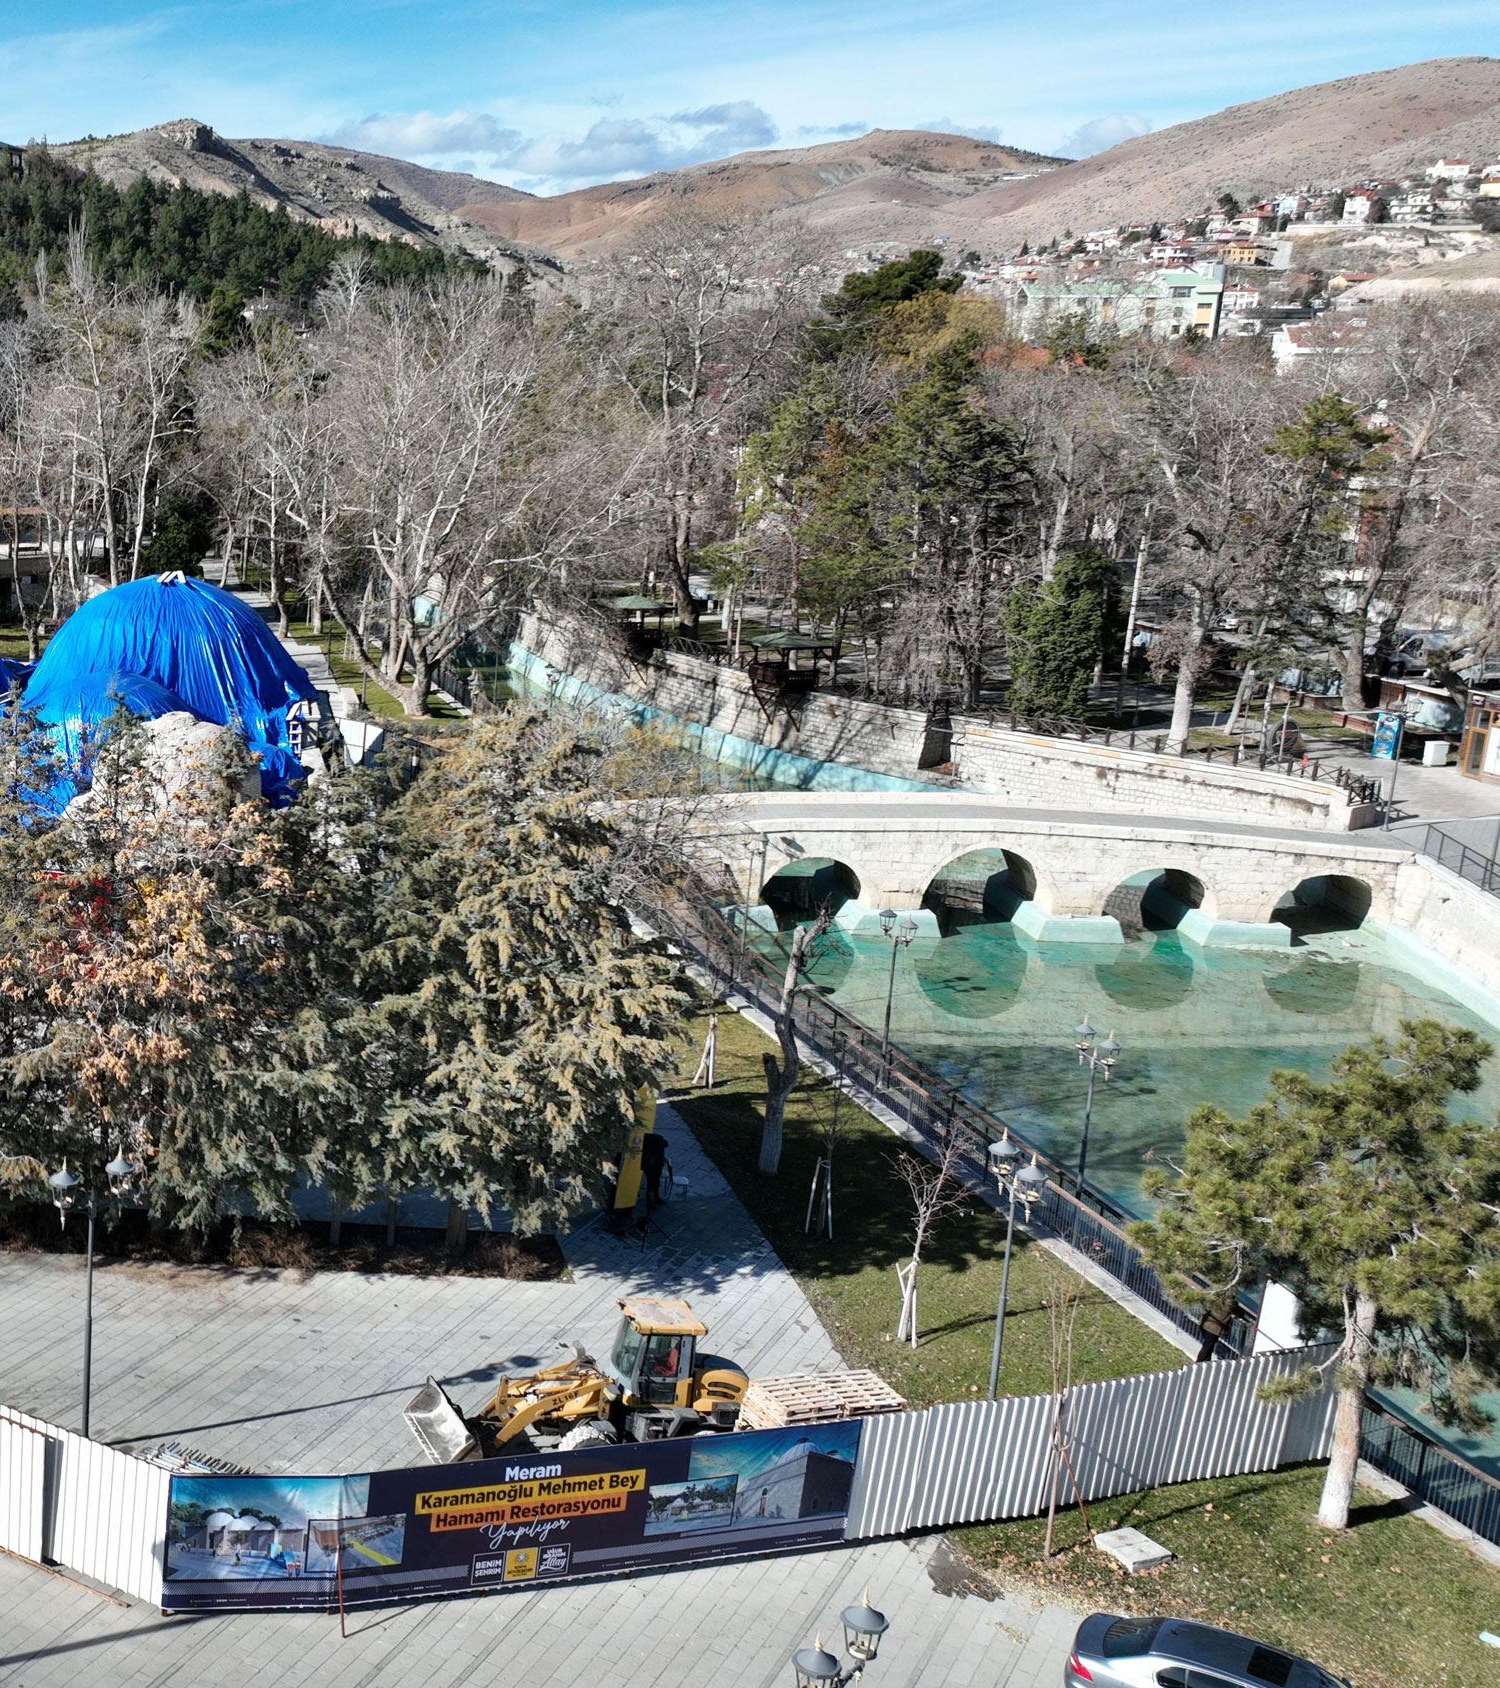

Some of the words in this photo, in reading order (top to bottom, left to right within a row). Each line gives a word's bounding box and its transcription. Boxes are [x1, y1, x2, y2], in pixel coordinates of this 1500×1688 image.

[504, 1463, 562, 1482] Meram
[421, 1483, 534, 1510] Karamanoğlu
[538, 1477, 604, 1497] Mehmet
[608, 1474, 639, 1490] Bey
[435, 1509, 506, 1529] Hamamı
[510, 1496, 621, 1519] Restorasyonu
[475, 1559, 502, 1569] BENİM
